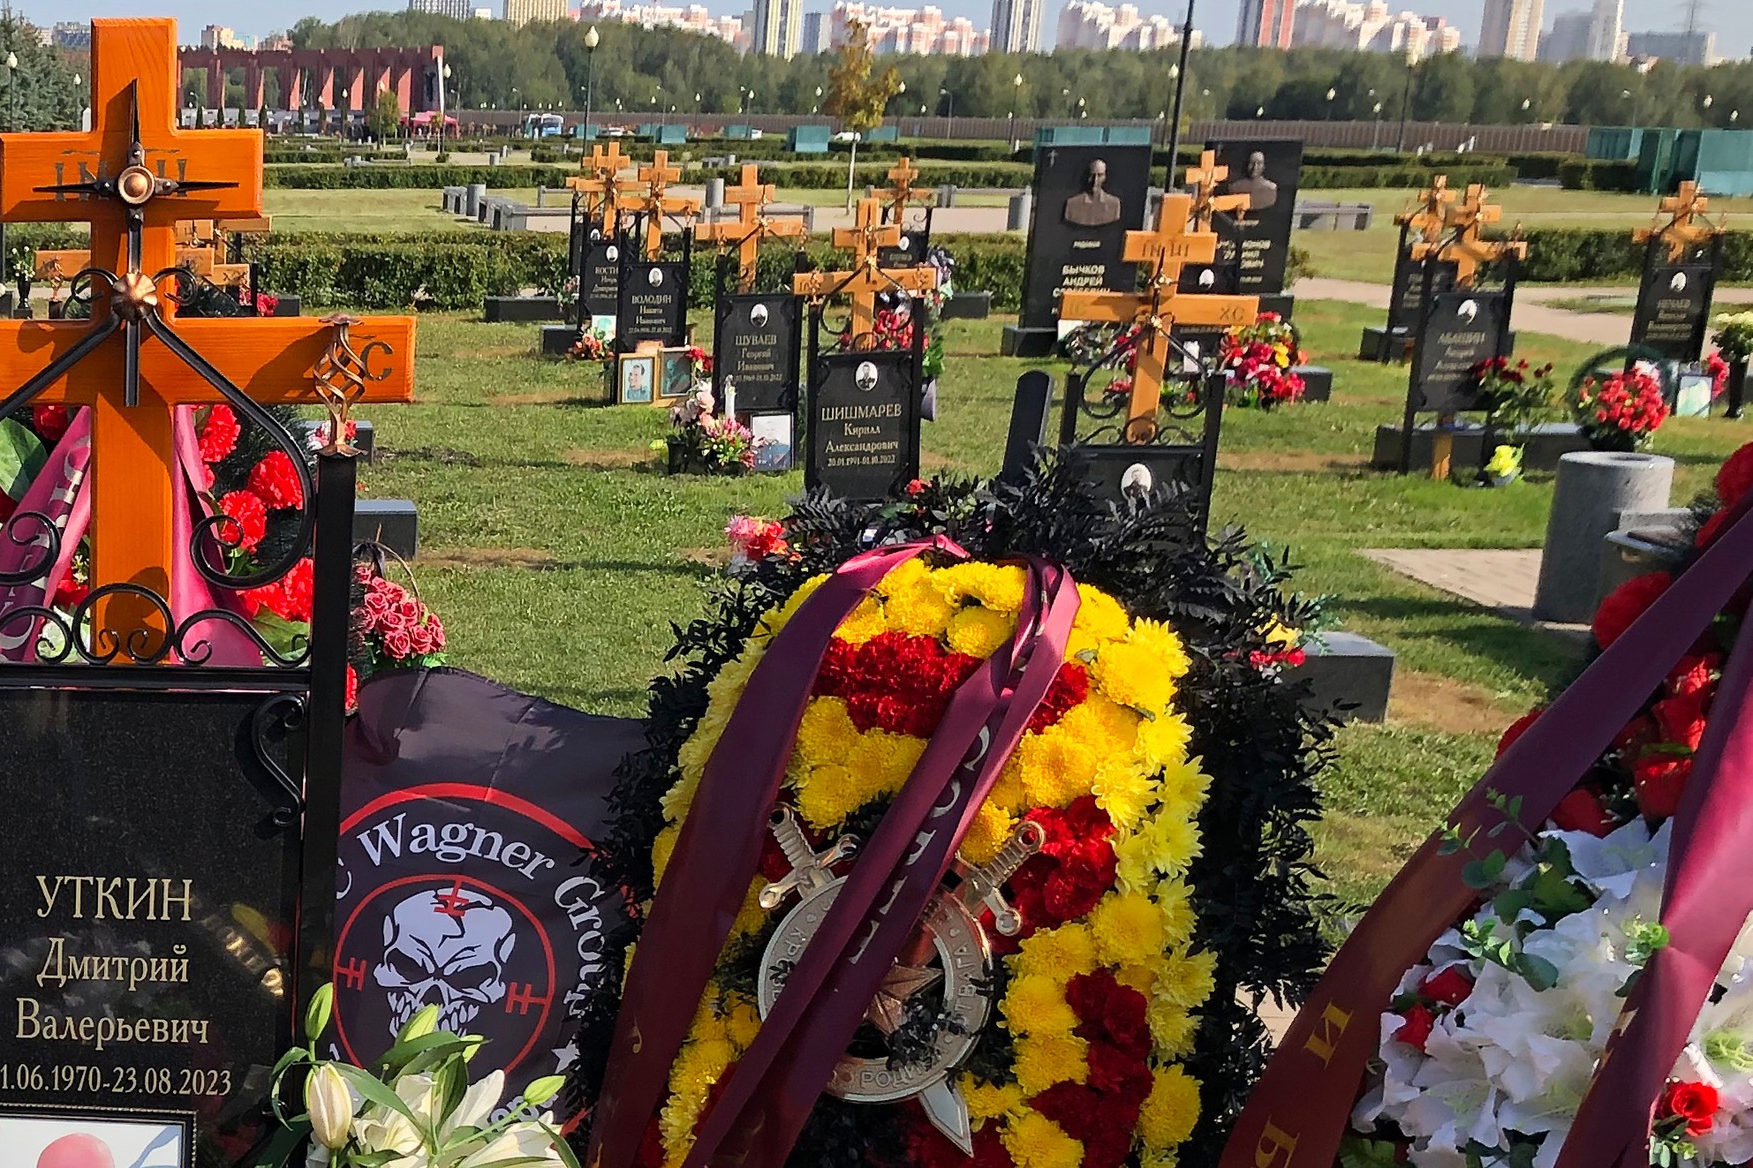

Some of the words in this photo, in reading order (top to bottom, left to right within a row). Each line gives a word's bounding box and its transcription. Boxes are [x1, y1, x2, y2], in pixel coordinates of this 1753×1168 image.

[1062, 265, 1106, 276] БЫЧКОВ
[1062, 275, 1104, 287] АНДРЕЙ
[631, 294, 672, 305] ВОЛОДИН
[735, 334, 777, 346] ШУВАЕВ
[821, 403, 903, 421] ШИШМАРЕВ
[844, 422, 881, 438] Кирилл
[825, 440, 899, 454] Александрович
[356, 812, 556, 880] Wagner
[35, 875, 193, 922] УТКИН
[35, 936, 190, 992] Дмитрий
[15, 997, 210, 1051] Валерьевич
[1303, 1000, 1354, 1070] И
